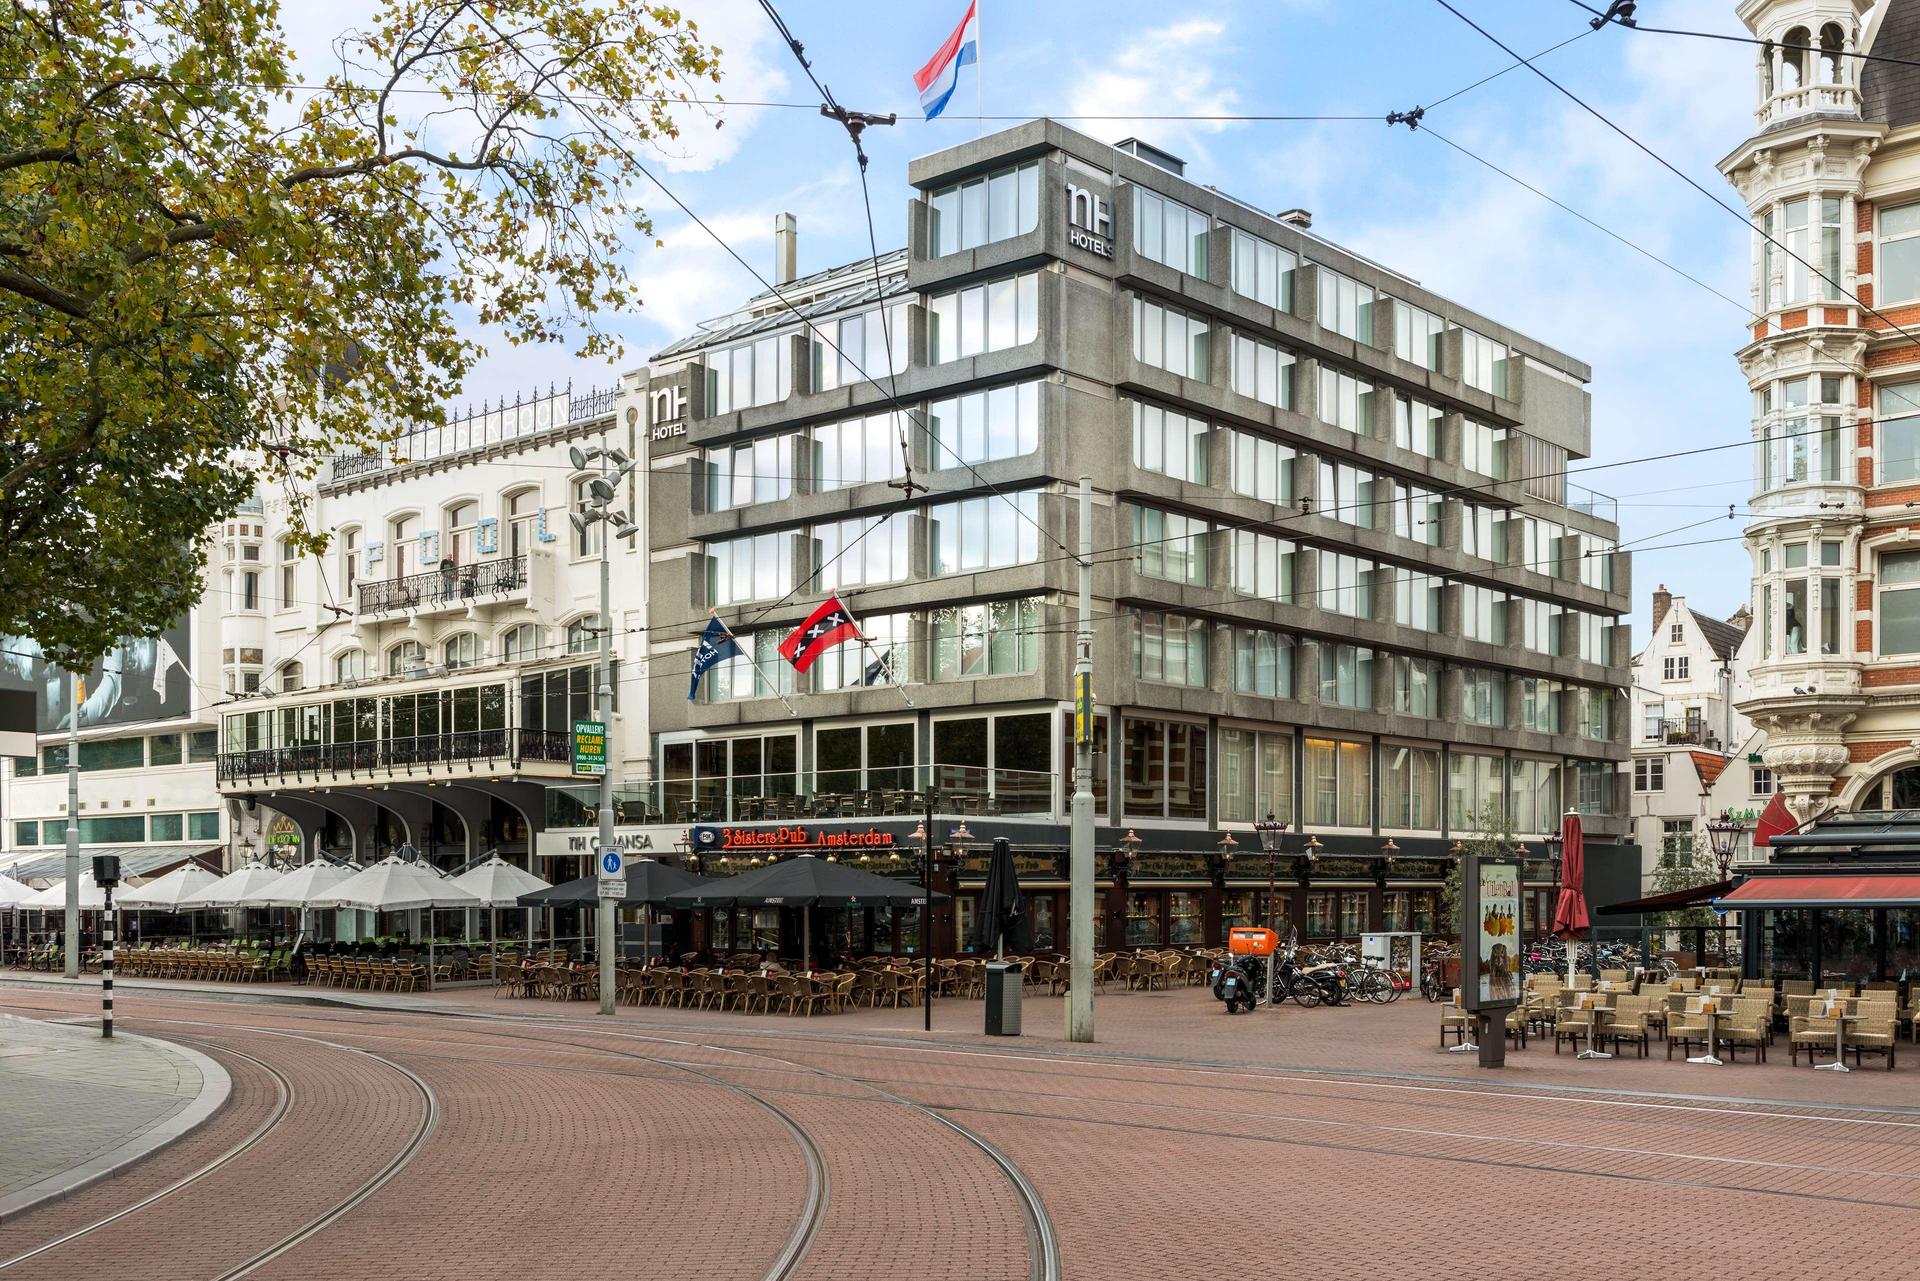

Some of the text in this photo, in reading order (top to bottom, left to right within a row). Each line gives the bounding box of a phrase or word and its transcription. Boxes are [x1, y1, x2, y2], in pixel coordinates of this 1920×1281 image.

[1070, 229, 1113, 257] HOTELS
[576, 735, 604, 744] RECLAME
[580, 744, 602, 754] HUREN
[590, 834, 654, 850] CANSA
[722, 826, 893, 846] 3 Sisters Pub Amsterdam
[911, 897, 927, 905] AMSTE
